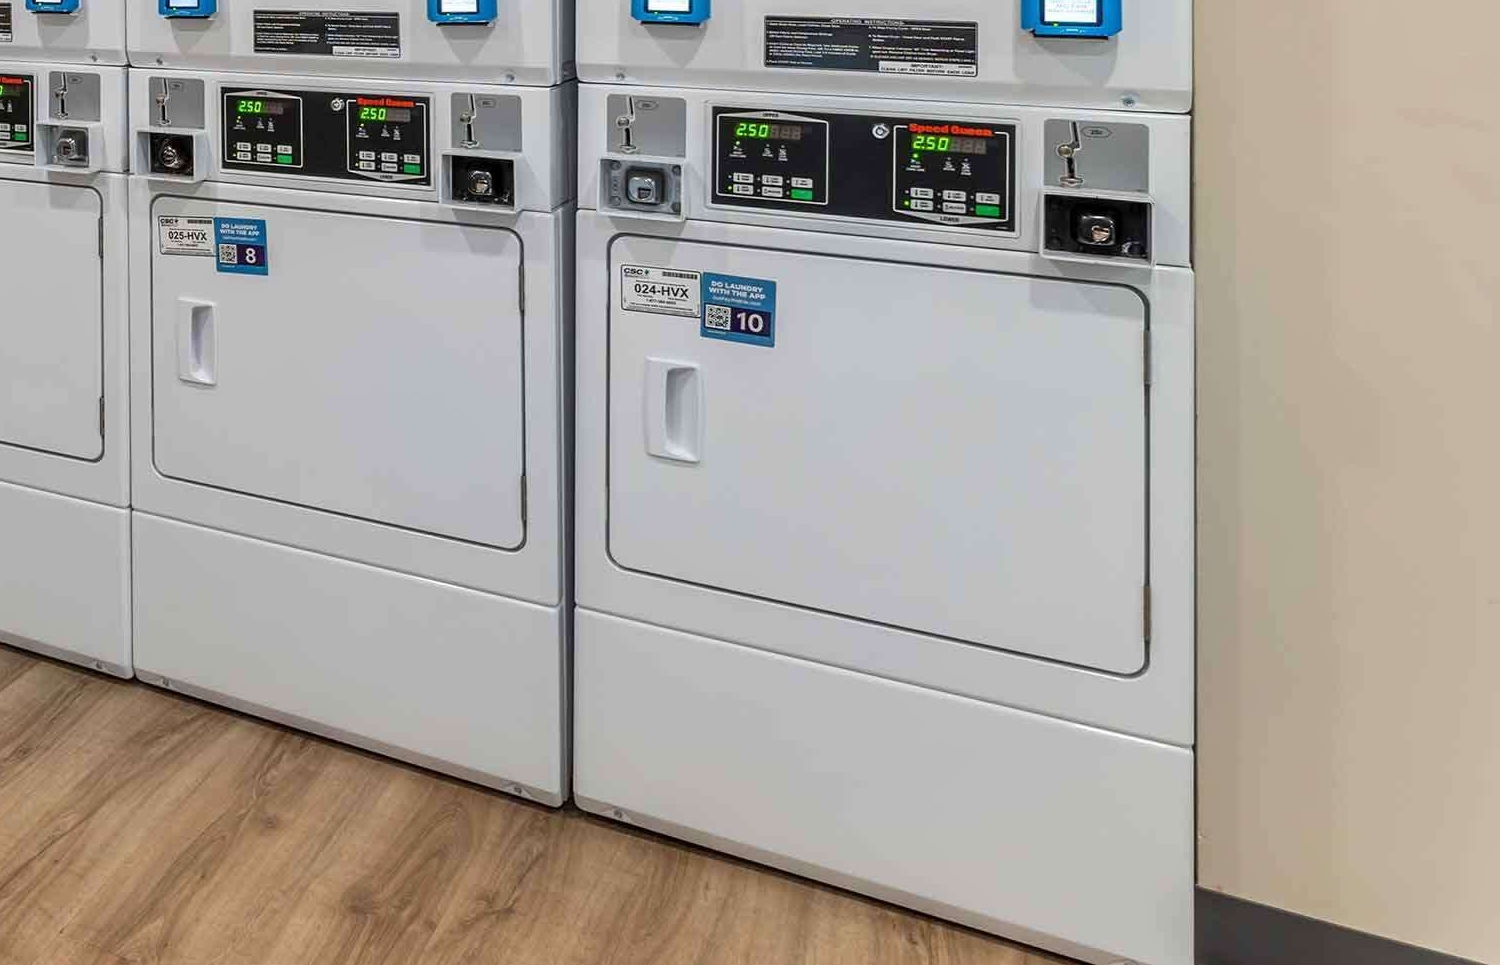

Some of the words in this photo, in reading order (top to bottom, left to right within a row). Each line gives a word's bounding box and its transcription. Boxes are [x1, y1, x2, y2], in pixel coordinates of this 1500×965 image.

[238, 100, 262, 113] 2.50
[357, 97, 385, 106] Speed
[360, 107, 387, 121] 2.50
[736, 123, 769, 138] 2.50
[908, 123, 949, 134] Speed
[950, 125, 994, 136] Queen
[913, 136, 949, 151] 2.50
[168, 230, 208, 241] 025-HVX
[245, 247, 256, 264] 8
[623, 267, 643, 275] CSC
[634, 283, 689, 299] 024-HVX
[708, 286, 730, 294] WITH
[731, 289, 748, 297] THE
[749, 292, 766, 300] APP
[724, 282, 763, 293] LAUNDRY
[737, 312, 764, 333] 10
